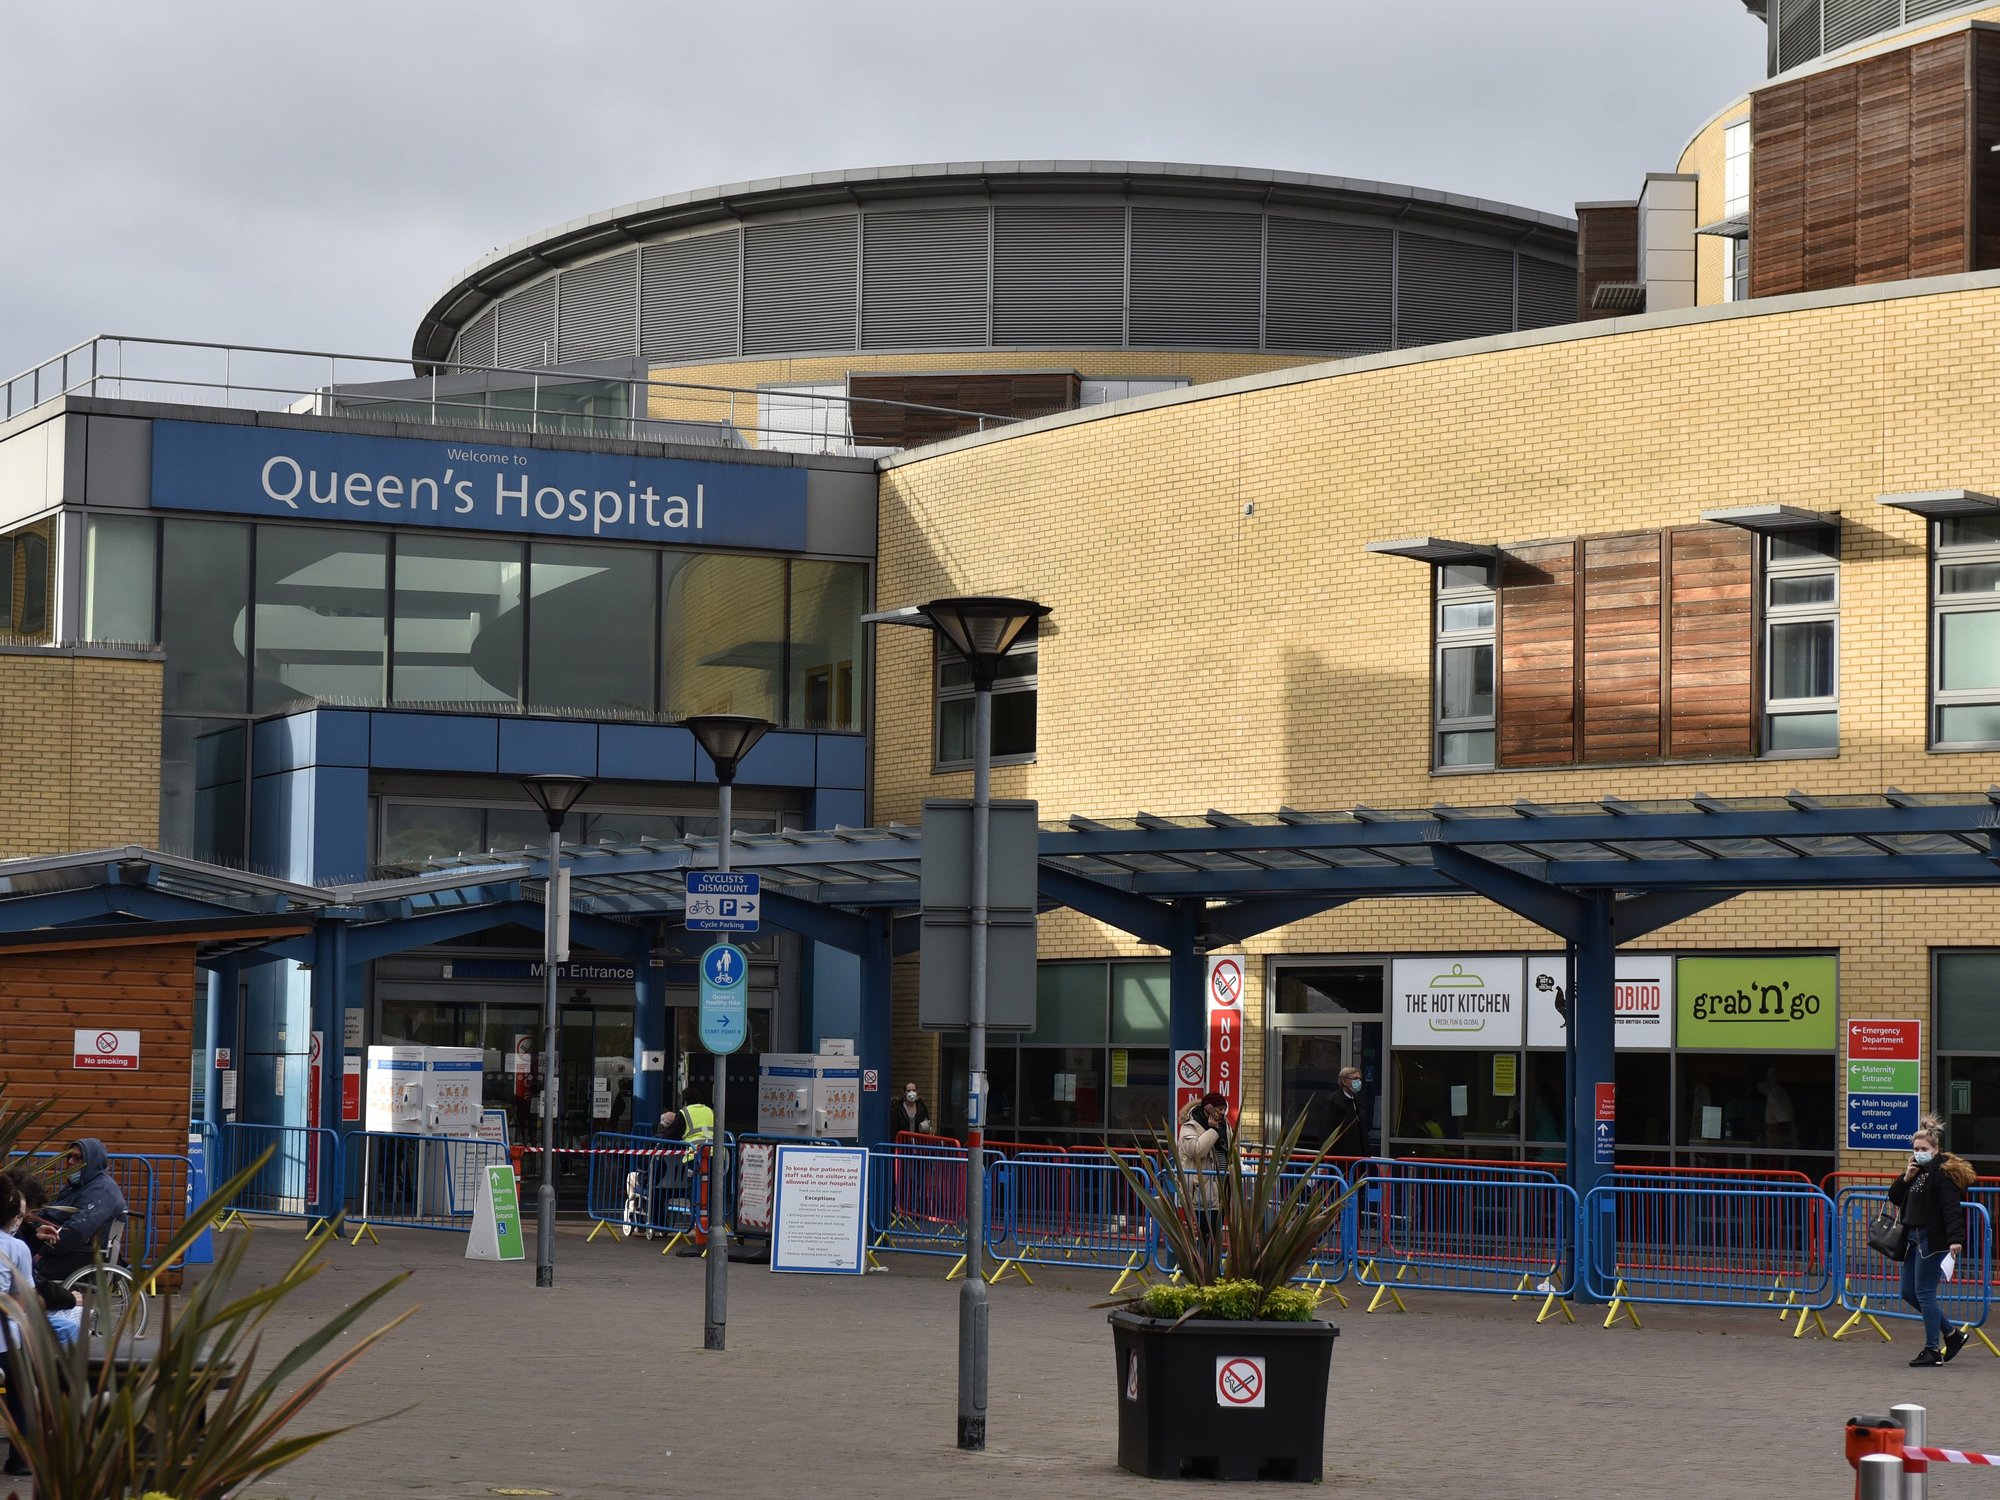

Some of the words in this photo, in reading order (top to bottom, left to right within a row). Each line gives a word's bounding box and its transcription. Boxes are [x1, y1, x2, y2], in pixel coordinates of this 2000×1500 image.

[447, 448, 508, 464] Welcome
[513, 453, 528, 466] to
[261, 456, 474, 514] Queen's
[495, 472, 704, 535] Hospital
[702, 874, 744, 884] CYCLISTS
[698, 884, 748, 892] DISMOUNT
[723, 900, 734, 914] P
[530, 963, 566, 976] Mn
[570, 964, 634, 979] Entrance
[1615, 986, 1660, 1010] DBIRD
[1405, 994, 1427, 1013] THE
[1432, 994, 1454, 1013] HOT
[1458, 994, 1510, 1013] KITCHEN
[1862, 1027, 1900, 1035] Emergency
[1862, 1036, 1904, 1044] Department
[97, 1058, 128, 1066] smoking
[1862, 1066, 1895, 1074] Maternity
[1881, 1100, 1909, 1109] hospital
